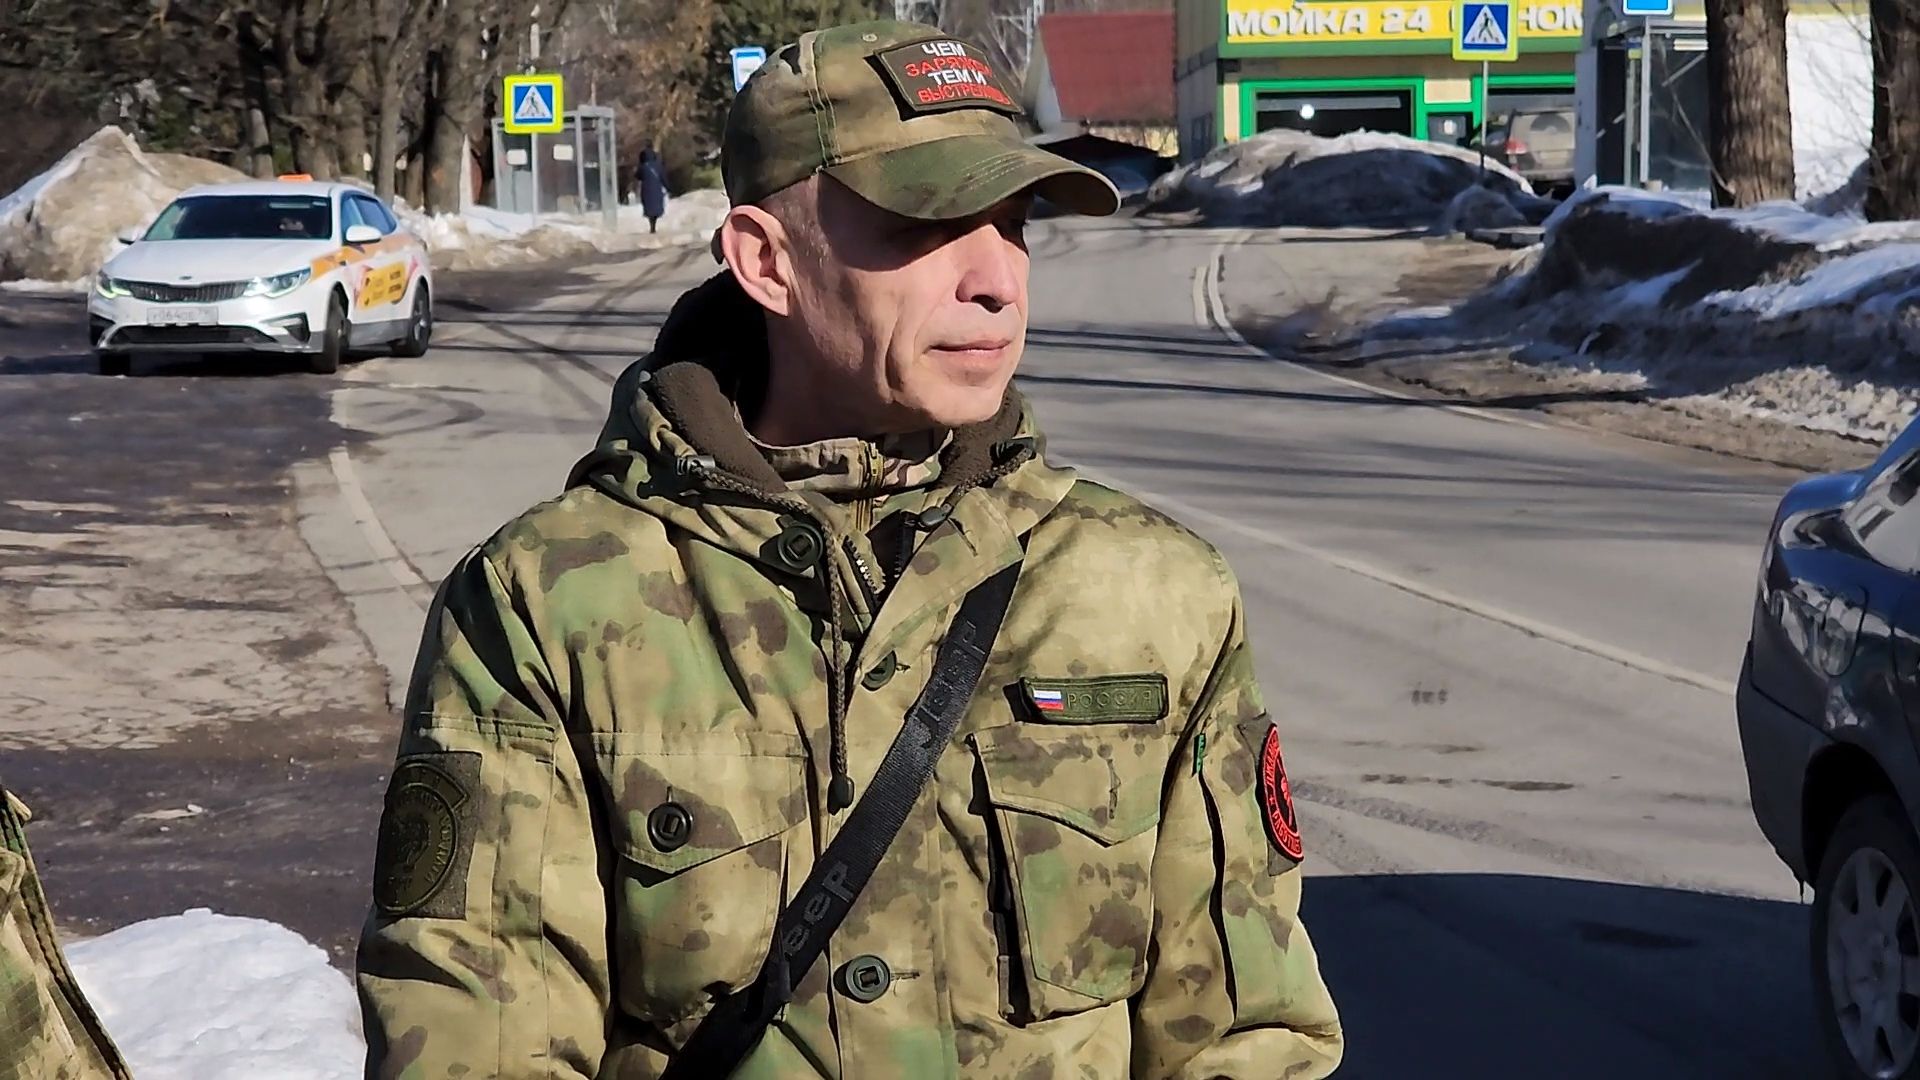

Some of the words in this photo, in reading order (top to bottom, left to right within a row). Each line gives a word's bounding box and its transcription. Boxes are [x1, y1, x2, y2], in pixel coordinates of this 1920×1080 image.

[1228, 1, 1368, 36] МОЙКА
[1381, 8, 1431, 33] 24
[922, 42, 966, 57] ЧЕМ
[928, 69, 973, 86] ТЕМ
[973, 69, 988, 86] И
[916, 619, 986, 749] Jeep
[783, 861, 855, 957] eep
